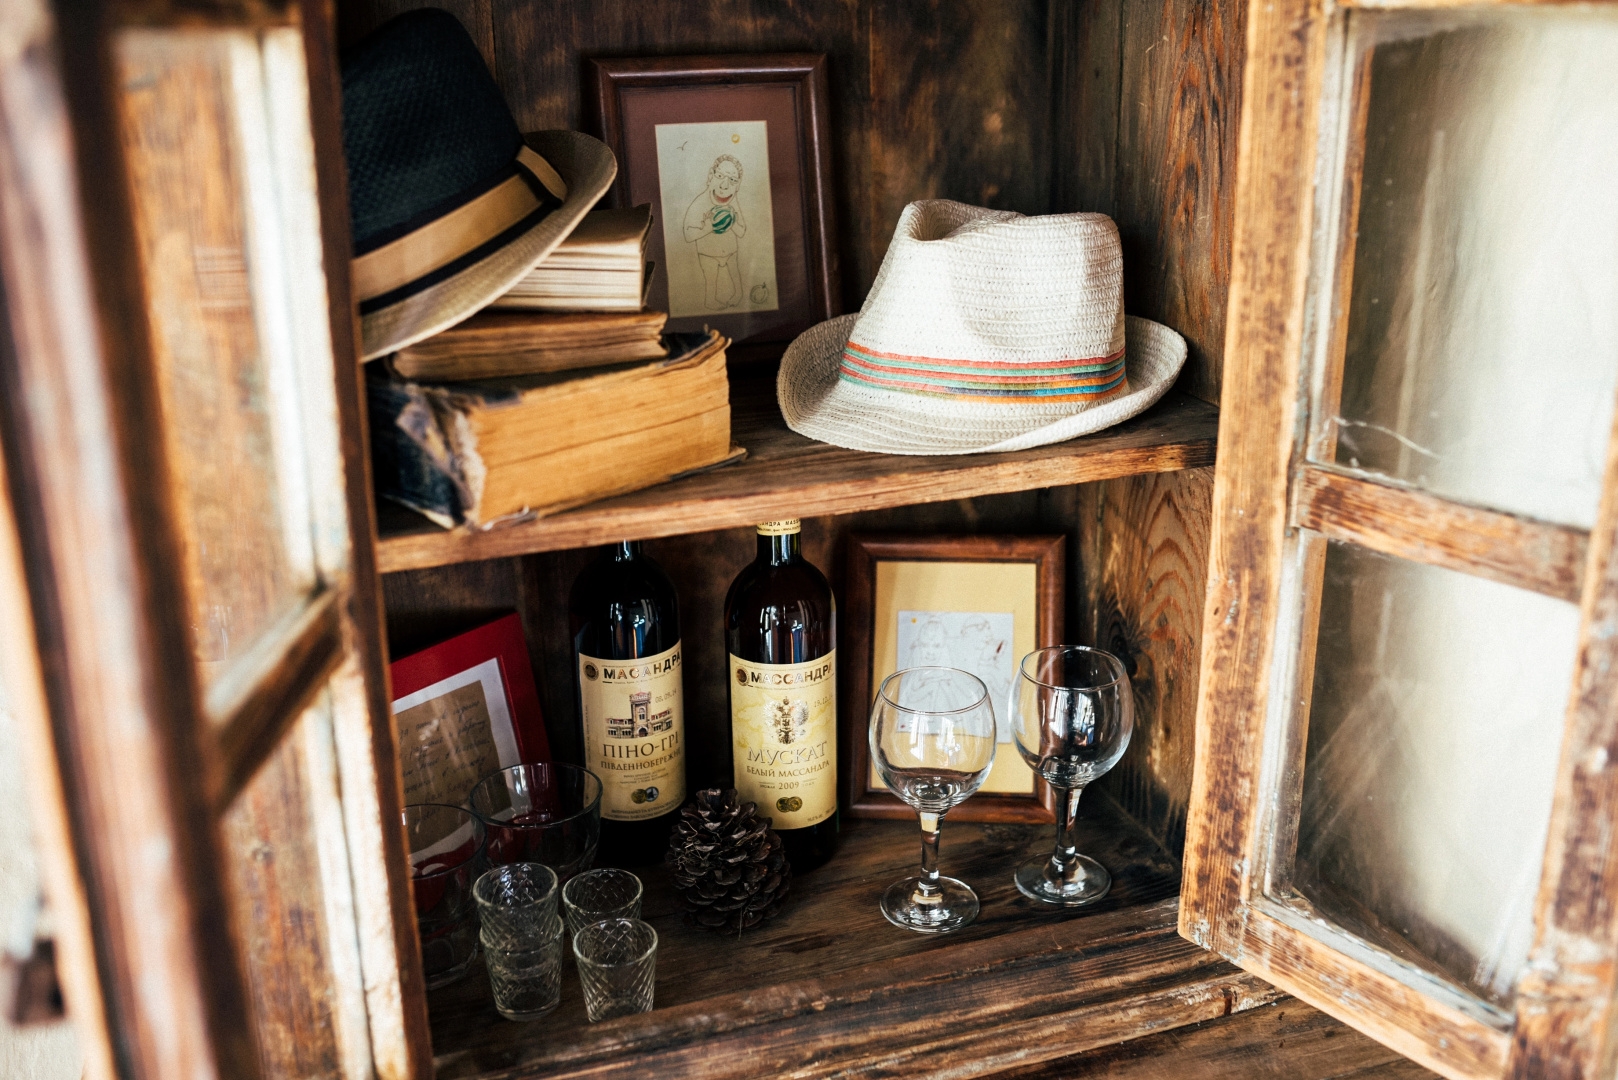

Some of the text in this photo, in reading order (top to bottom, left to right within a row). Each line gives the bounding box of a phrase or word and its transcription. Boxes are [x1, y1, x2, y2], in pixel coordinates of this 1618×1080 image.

[604, 650, 681, 679] МАСАНДРА
[747, 740, 828, 766] МУСКАТ
[746, 759, 830, 777] БЕЛЫЙ МАССАНДРА
[778, 781, 800, 790] 2009
